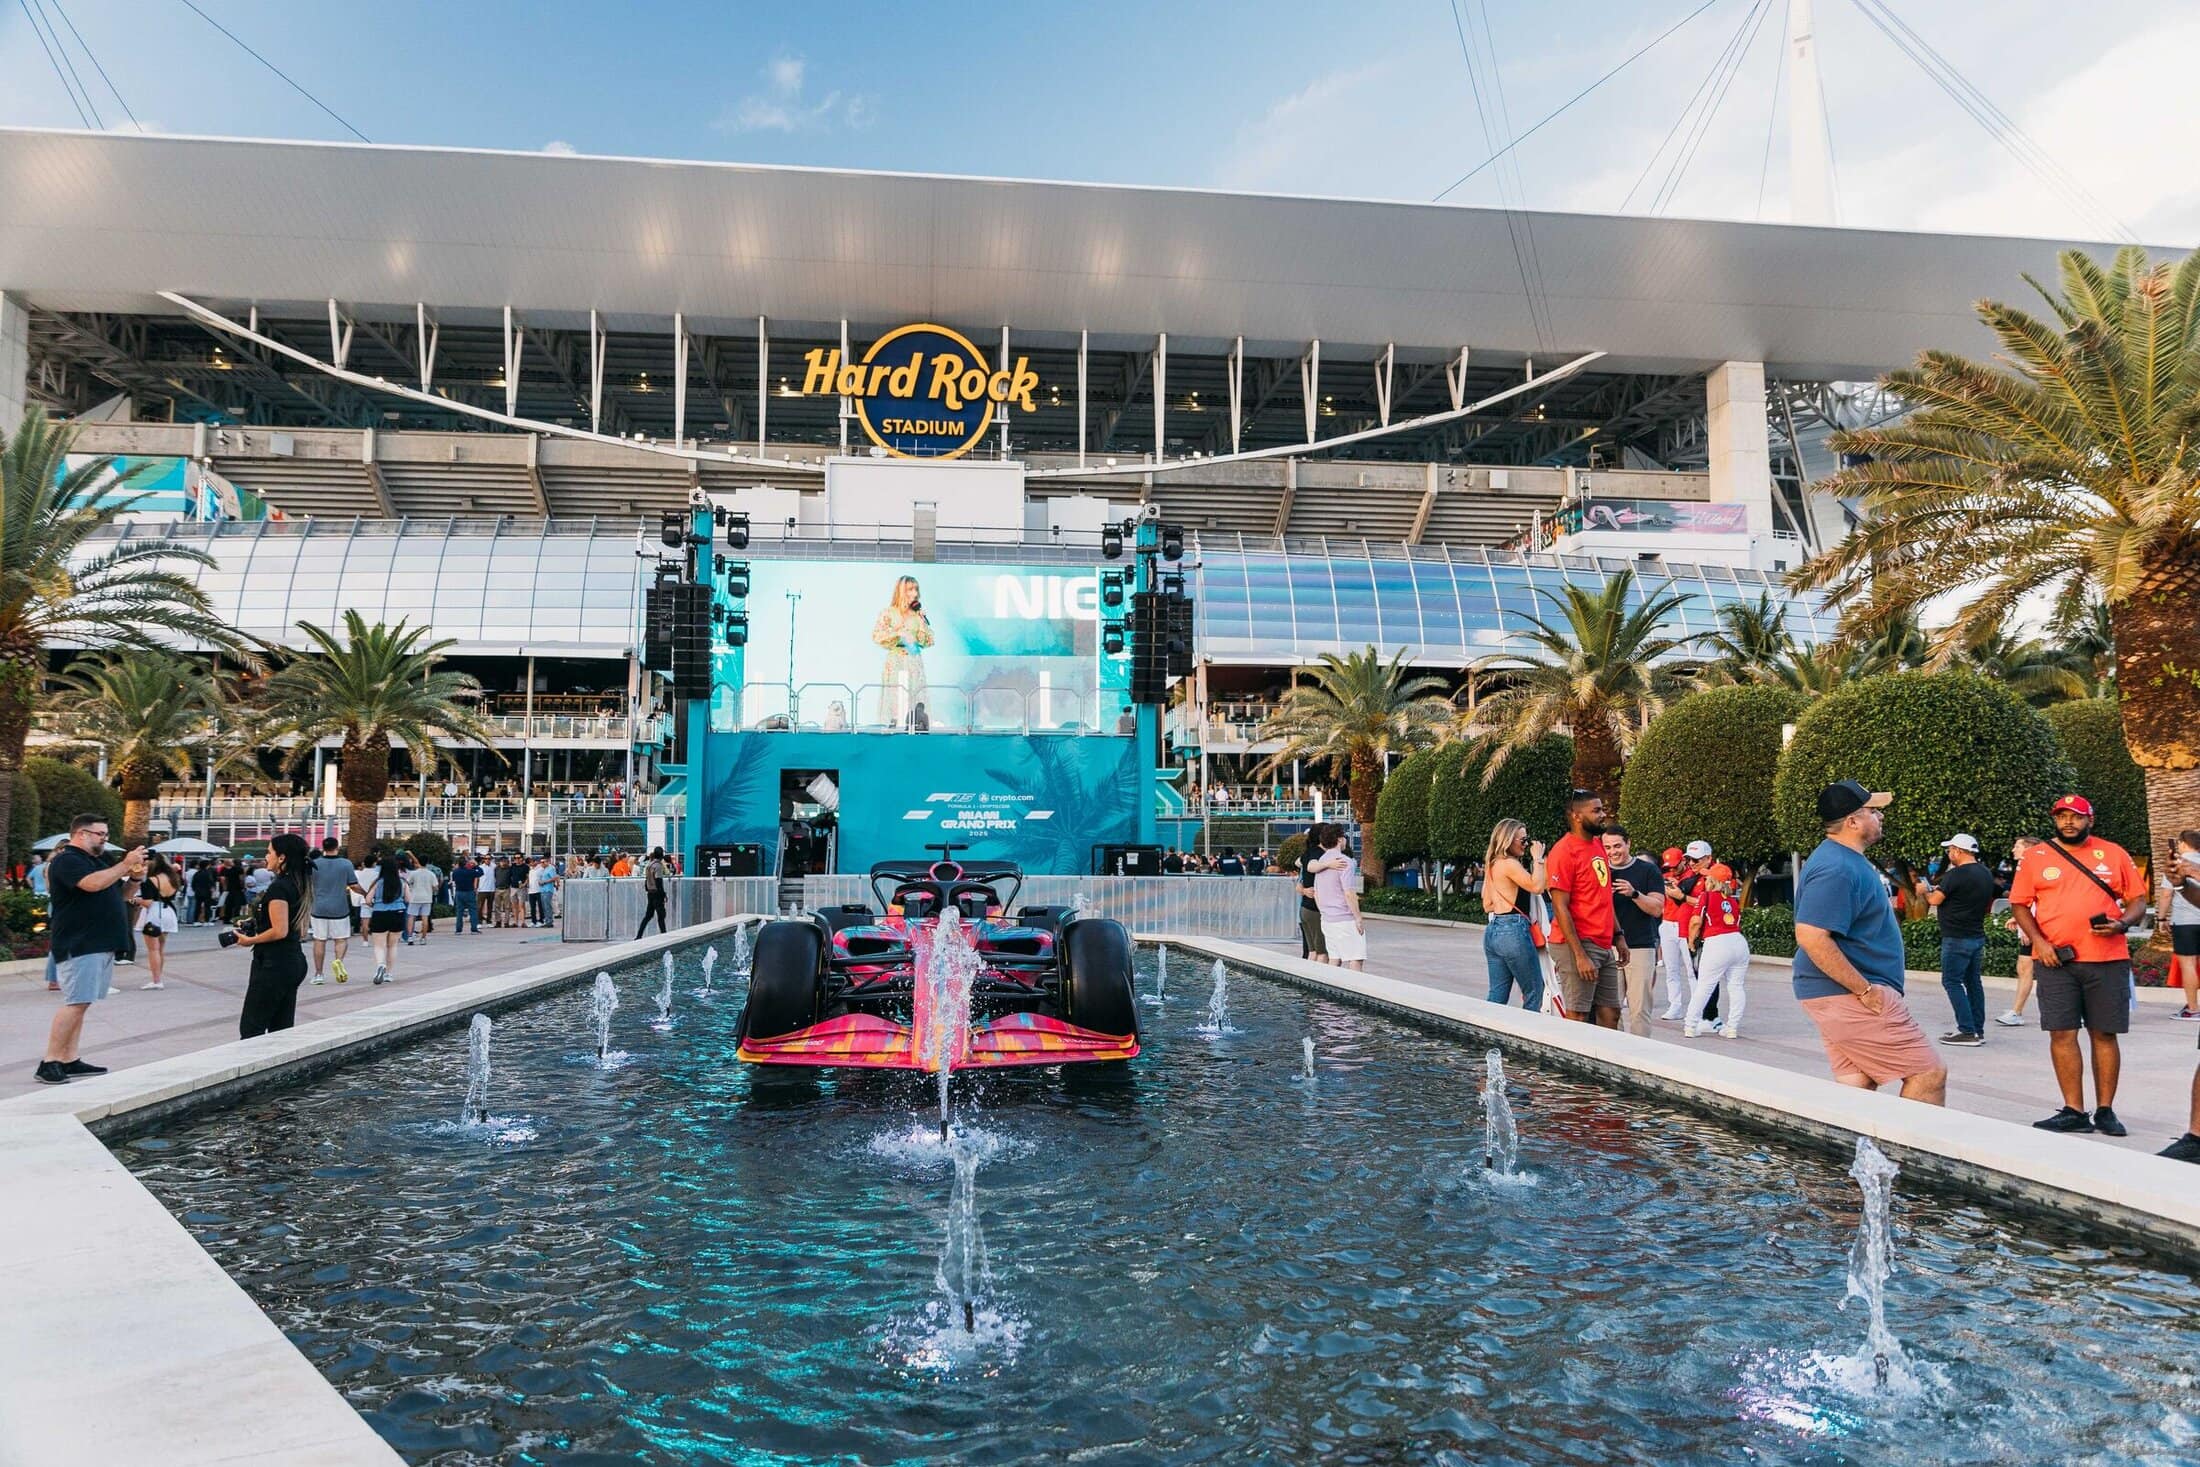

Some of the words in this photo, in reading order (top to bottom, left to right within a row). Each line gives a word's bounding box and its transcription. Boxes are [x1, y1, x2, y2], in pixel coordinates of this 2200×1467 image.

[802, 348, 924, 398] Hard
[928, 353, 1040, 412] Rock
[882, 418, 965, 436] STADIUM
[991, 793, 1034, 802] crypto.com
[958, 810, 1000, 819] MIAMI
[941, 820, 985, 829] GRAND
[987, 820, 1016, 829] PRIX
